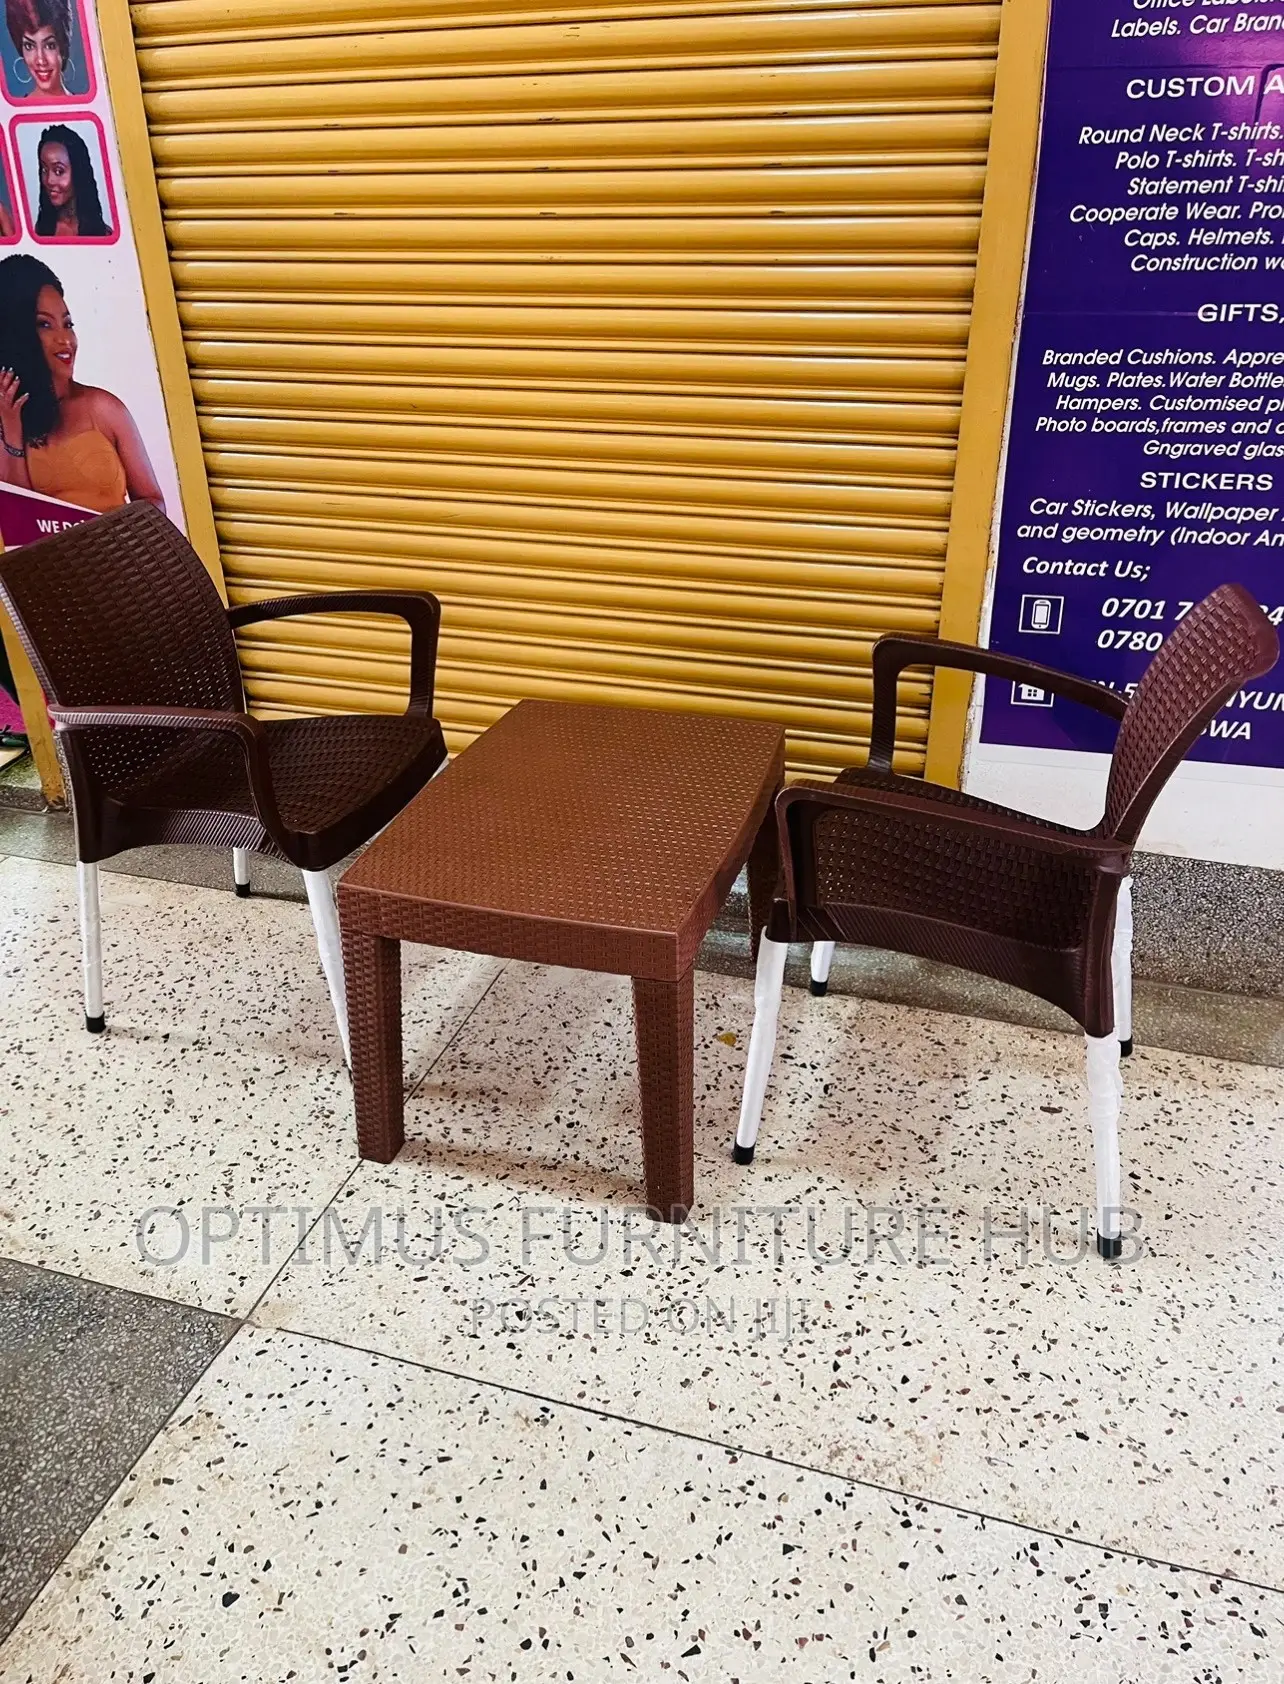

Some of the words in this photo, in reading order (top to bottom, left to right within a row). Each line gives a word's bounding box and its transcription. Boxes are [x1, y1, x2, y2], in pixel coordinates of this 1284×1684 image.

[1111, 16, 1182, 38] Labels.
[1189, 14, 1231, 35] Car
[1233, 12, 1284, 33] Bran
[1126, 75, 1255, 99] CUSTOM
[1079, 125, 1146, 145] Round
[1149, 124, 1206, 143] Neck
[1211, 121, 1284, 141] T-shirts.
[1115, 151, 1160, 170] Polo
[1166, 150, 1237, 168] T-shirts.
[1127, 177, 1233, 196] Statement
[1069, 204, 1179, 225] Cooperate
[1186, 203, 1242, 221] Wear.
[1249, 201, 1284, 219] Pro
[1124, 229, 1180, 249] Caps.
[1188, 227, 1274, 246] Helmets.
[1131, 253, 1258, 272] Construction
[1197, 303, 1284, 325] GIFTS,
[1042, 349, 1123, 365] Branded
[1127, 349, 1216, 365] Cushions.
[1223, 349, 1284, 368] Appre
[1047, 372, 1101, 391] Mugs.
[1228, 372, 1284, 388] Bottle
[1056, 394, 1142, 413] Hampers.
[1150, 394, 1262, 412] Customised
[1035, 417, 1087, 432] Photo
[1231, 419, 1272, 434] and
[1143, 440, 1241, 459] Gngraved
[1243, 441, 1284, 460] glas
[1140, 472, 1274, 491] STICKERS
[1029, 498, 1068, 516] Car
[1071, 500, 1156, 519] Stickers,
[1165, 501, 1279, 524] Wallpaper
[36, 518, 61, 534] WE
[1017, 523, 1058, 539] and
[1061, 526, 1165, 546] geometry
[1170, 527, 1250, 546] (Indoor
[1022, 556, 1109, 578] Contact
[1114, 560, 1151, 582] Us;
[1101, 597, 1165, 620] 0701
[1097, 629, 1164, 652] 0780
[1200, 719, 1252, 740] WA
